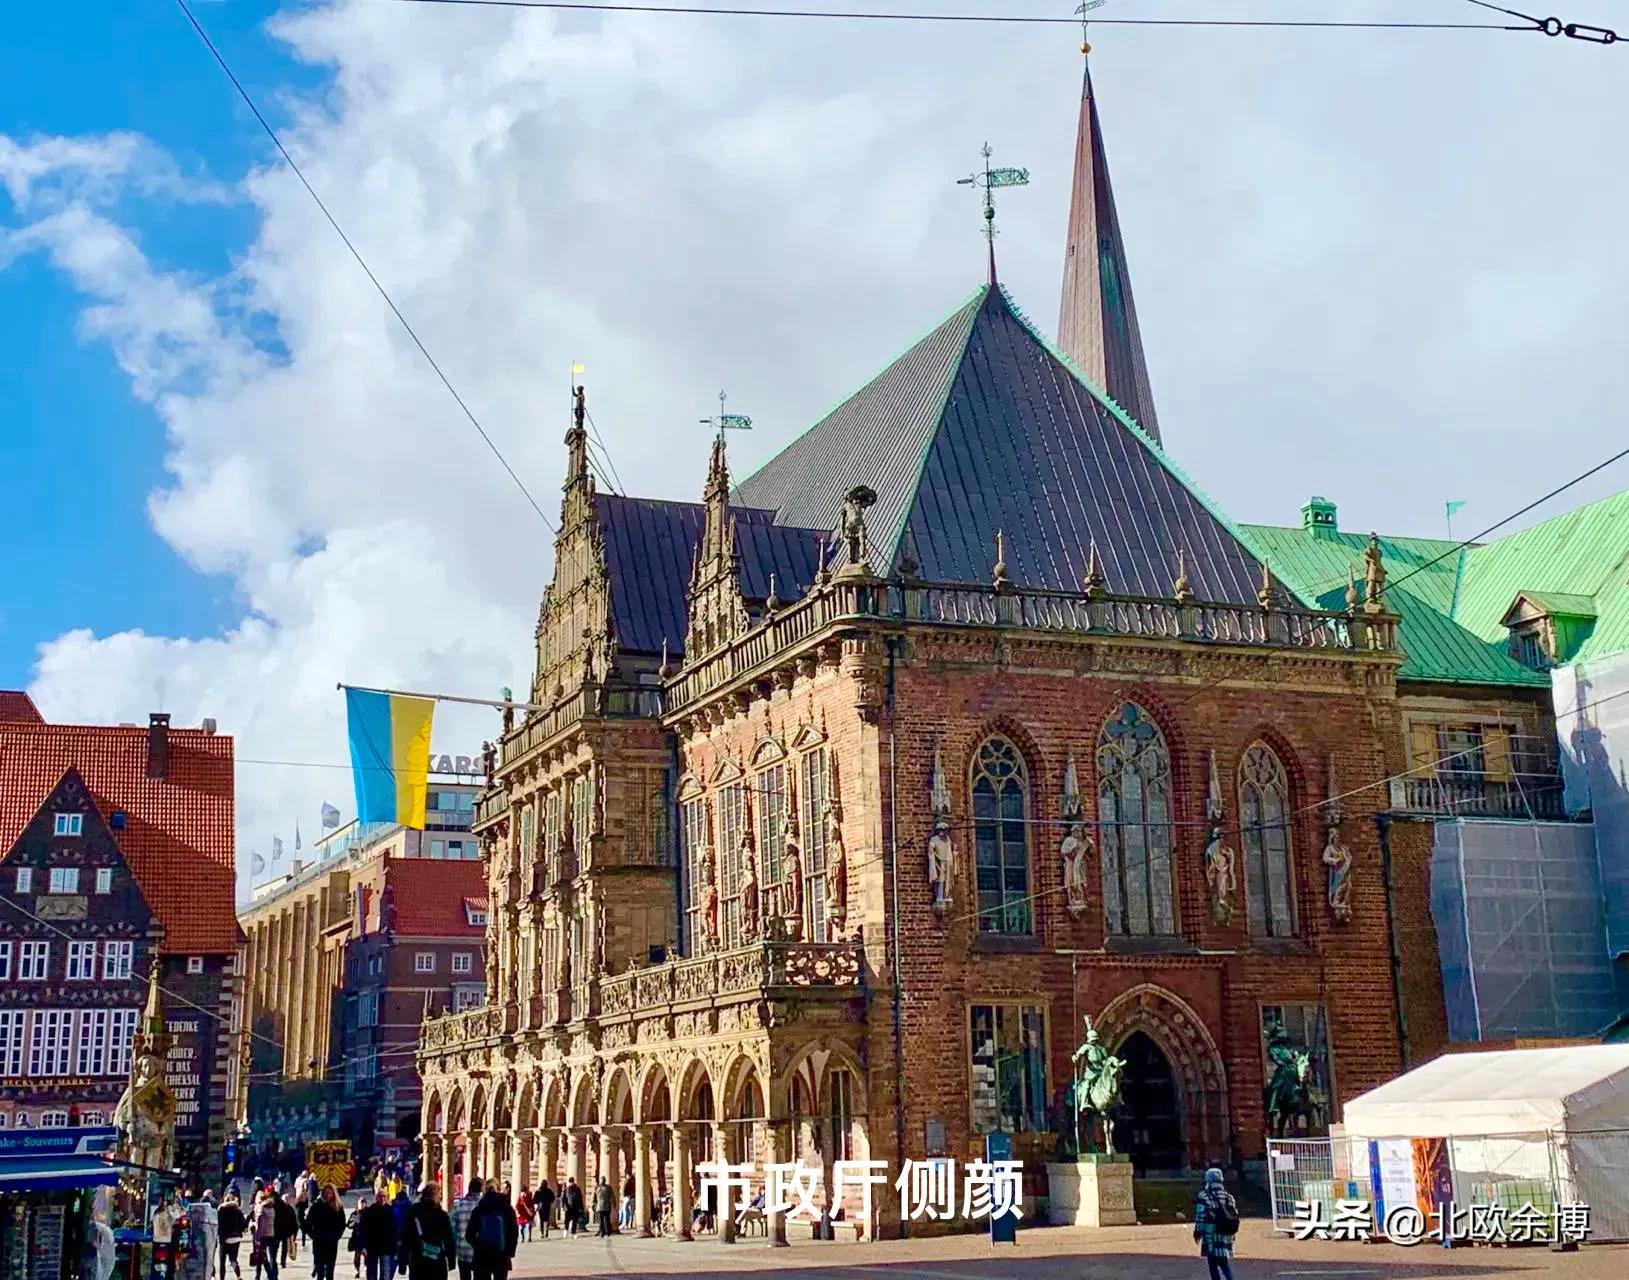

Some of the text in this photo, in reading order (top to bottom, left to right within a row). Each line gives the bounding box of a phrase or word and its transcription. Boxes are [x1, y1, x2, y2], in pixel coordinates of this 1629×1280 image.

[428, 754, 496, 775] KARS
[166, 1020, 200, 1033] EDENKE
[176, 1061, 192, 1073] DAS
[58, 1078, 92, 1086] MARKT
[165, 1074, 201, 1086] CHICKSAL
[23, 1136, 74, 1147] Souvenirs
